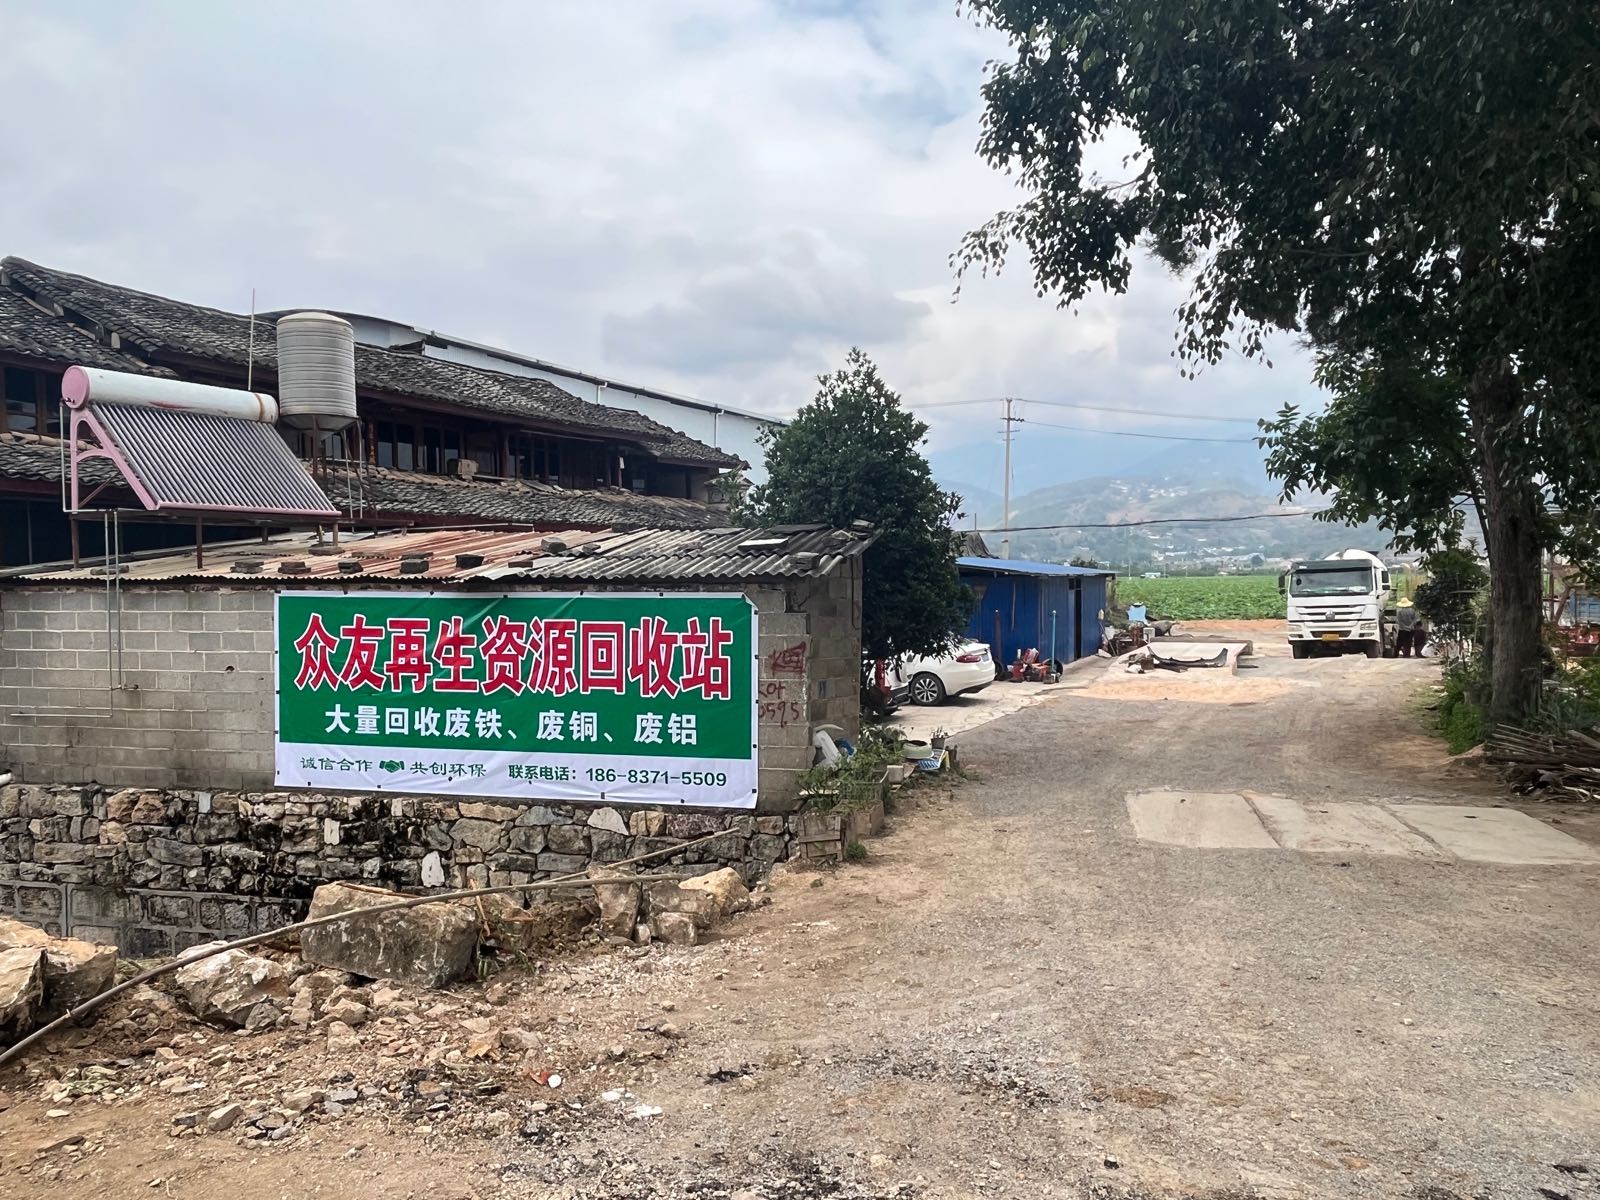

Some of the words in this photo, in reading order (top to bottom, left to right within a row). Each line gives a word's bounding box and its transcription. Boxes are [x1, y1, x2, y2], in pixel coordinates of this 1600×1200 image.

[293, 612, 734, 700] 众友再生资源回收站
[300, 756, 373, 773] 诚信合作
[409, 761, 487, 778] 共创环保
